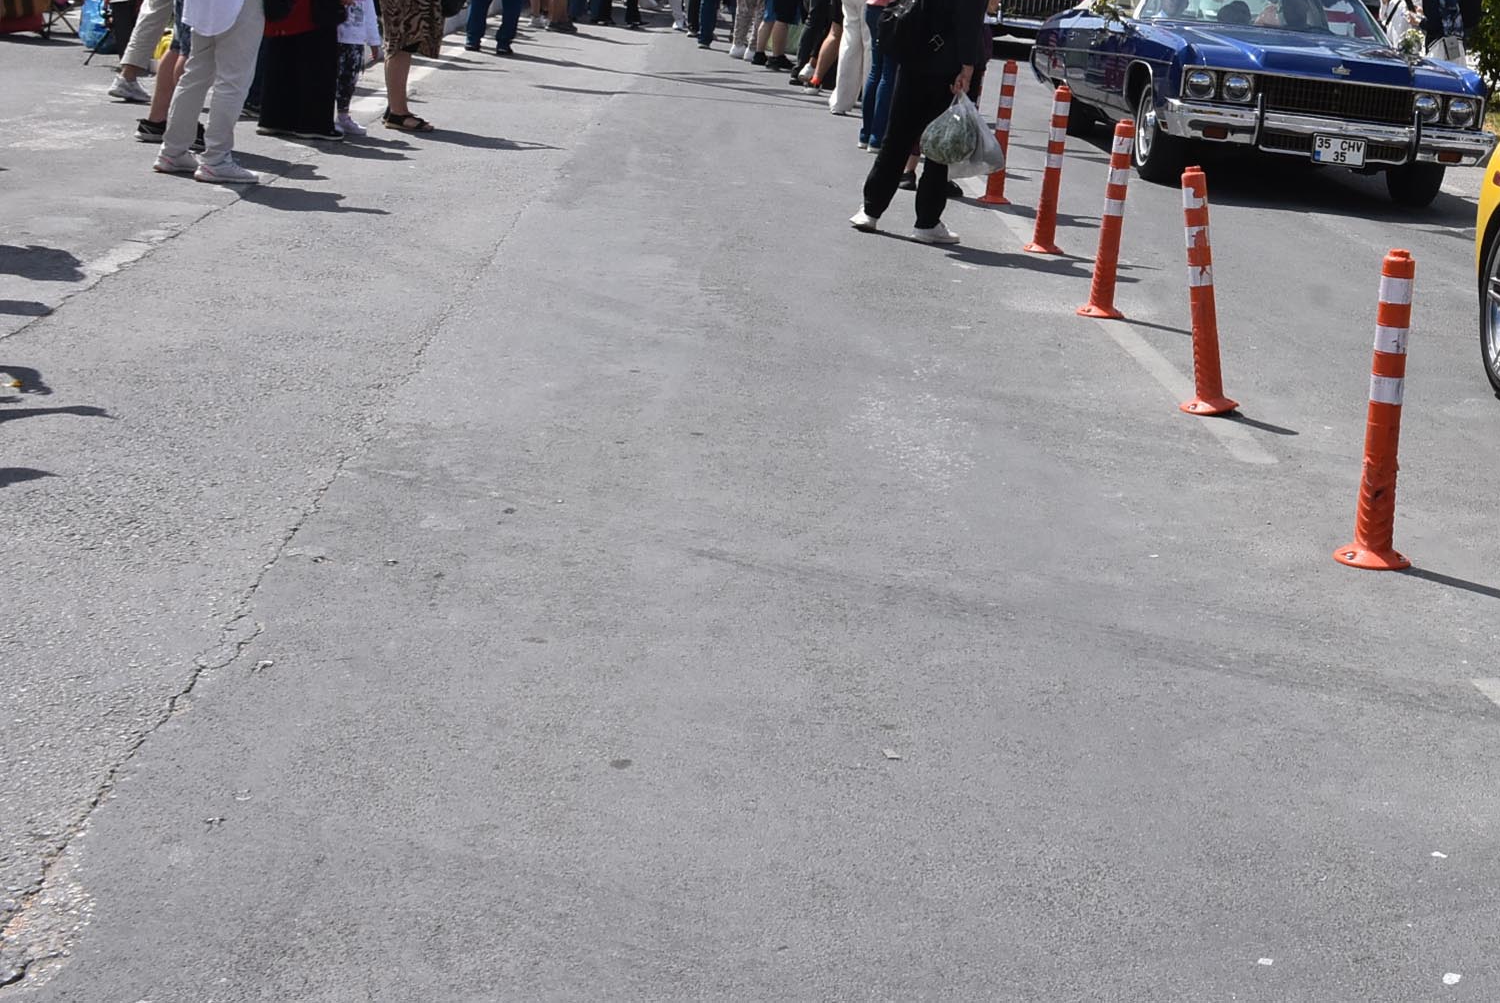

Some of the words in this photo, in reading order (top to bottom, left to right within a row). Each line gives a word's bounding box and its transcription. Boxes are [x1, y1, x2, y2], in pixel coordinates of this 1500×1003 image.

[1317, 138, 1332, 149] 35
[1340, 140, 1363, 153] CHV
[1332, 151, 1348, 163] 35
